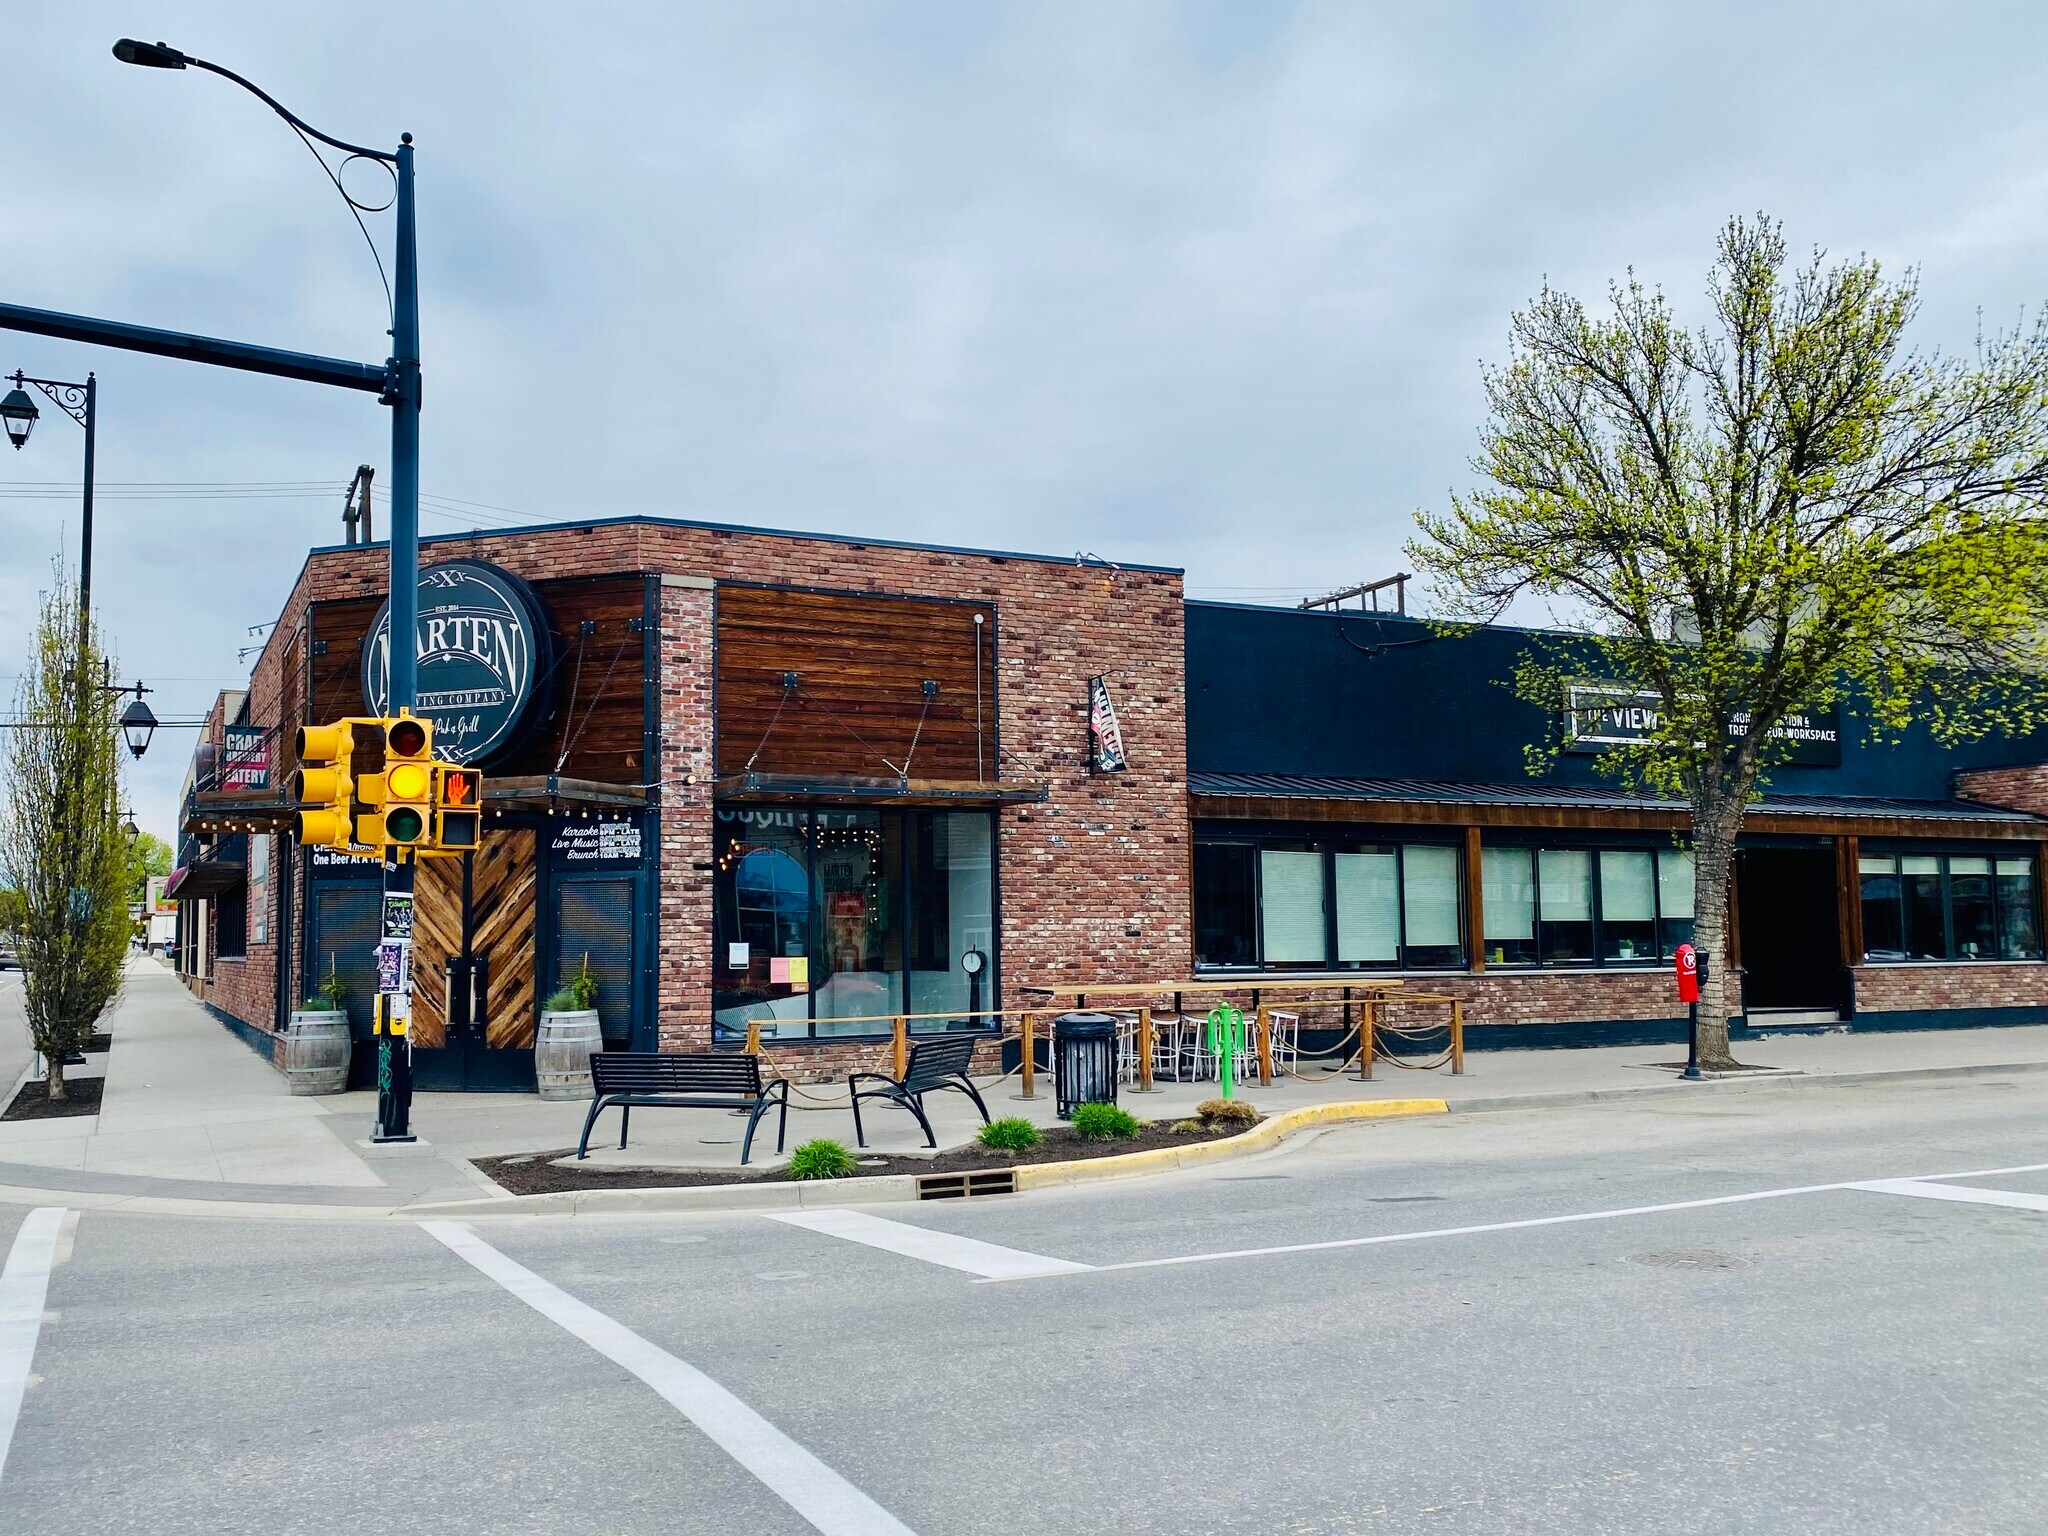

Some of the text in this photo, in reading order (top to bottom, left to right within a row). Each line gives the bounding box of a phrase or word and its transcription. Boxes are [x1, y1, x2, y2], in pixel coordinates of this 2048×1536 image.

[449, 690, 507, 705] COMPANY
[1612, 708, 1658, 730] VIEW
[1804, 716, 1811, 728] &
[457, 714, 480, 745] Grill
[1786, 728, 1837, 742] WORKSPACE
[562, 825, 599, 836] Karaoke
[552, 837, 599, 849] Live Music
[313, 853, 329, 865] One
[331, 853, 350, 865] Beer
[567, 848, 599, 859] Brunch
